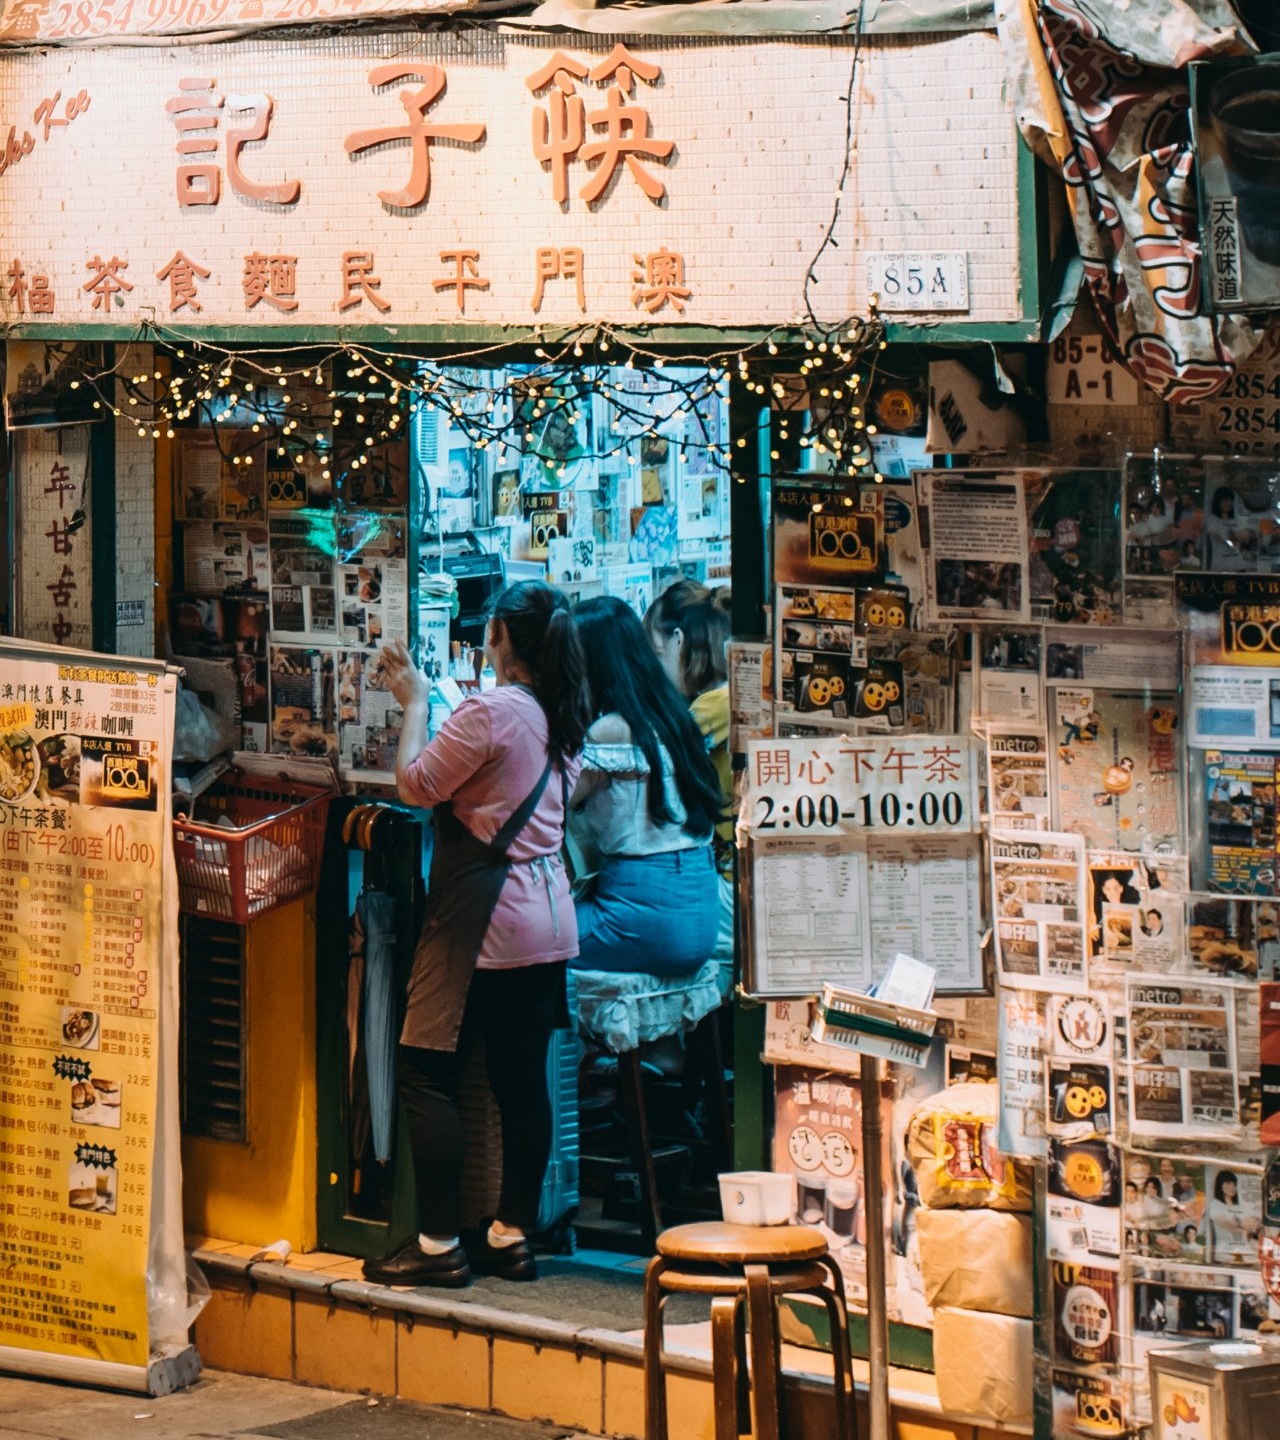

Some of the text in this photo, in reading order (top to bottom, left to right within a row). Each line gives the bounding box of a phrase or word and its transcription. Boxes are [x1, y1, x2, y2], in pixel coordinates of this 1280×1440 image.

[32, 89, 92, 164] Kee
[1212, 199, 1239, 301] 天然味道
[881, 263, 948, 299] 85A
[1065, 369, 1115, 402] A-1
[114, 741, 132, 753] TVB
[991, 735, 1038, 754] metro
[754, 745, 964, 788] 開心下午茶
[755, 791, 964, 831] 2:00-10:00
[995, 841, 1041, 860] metro
